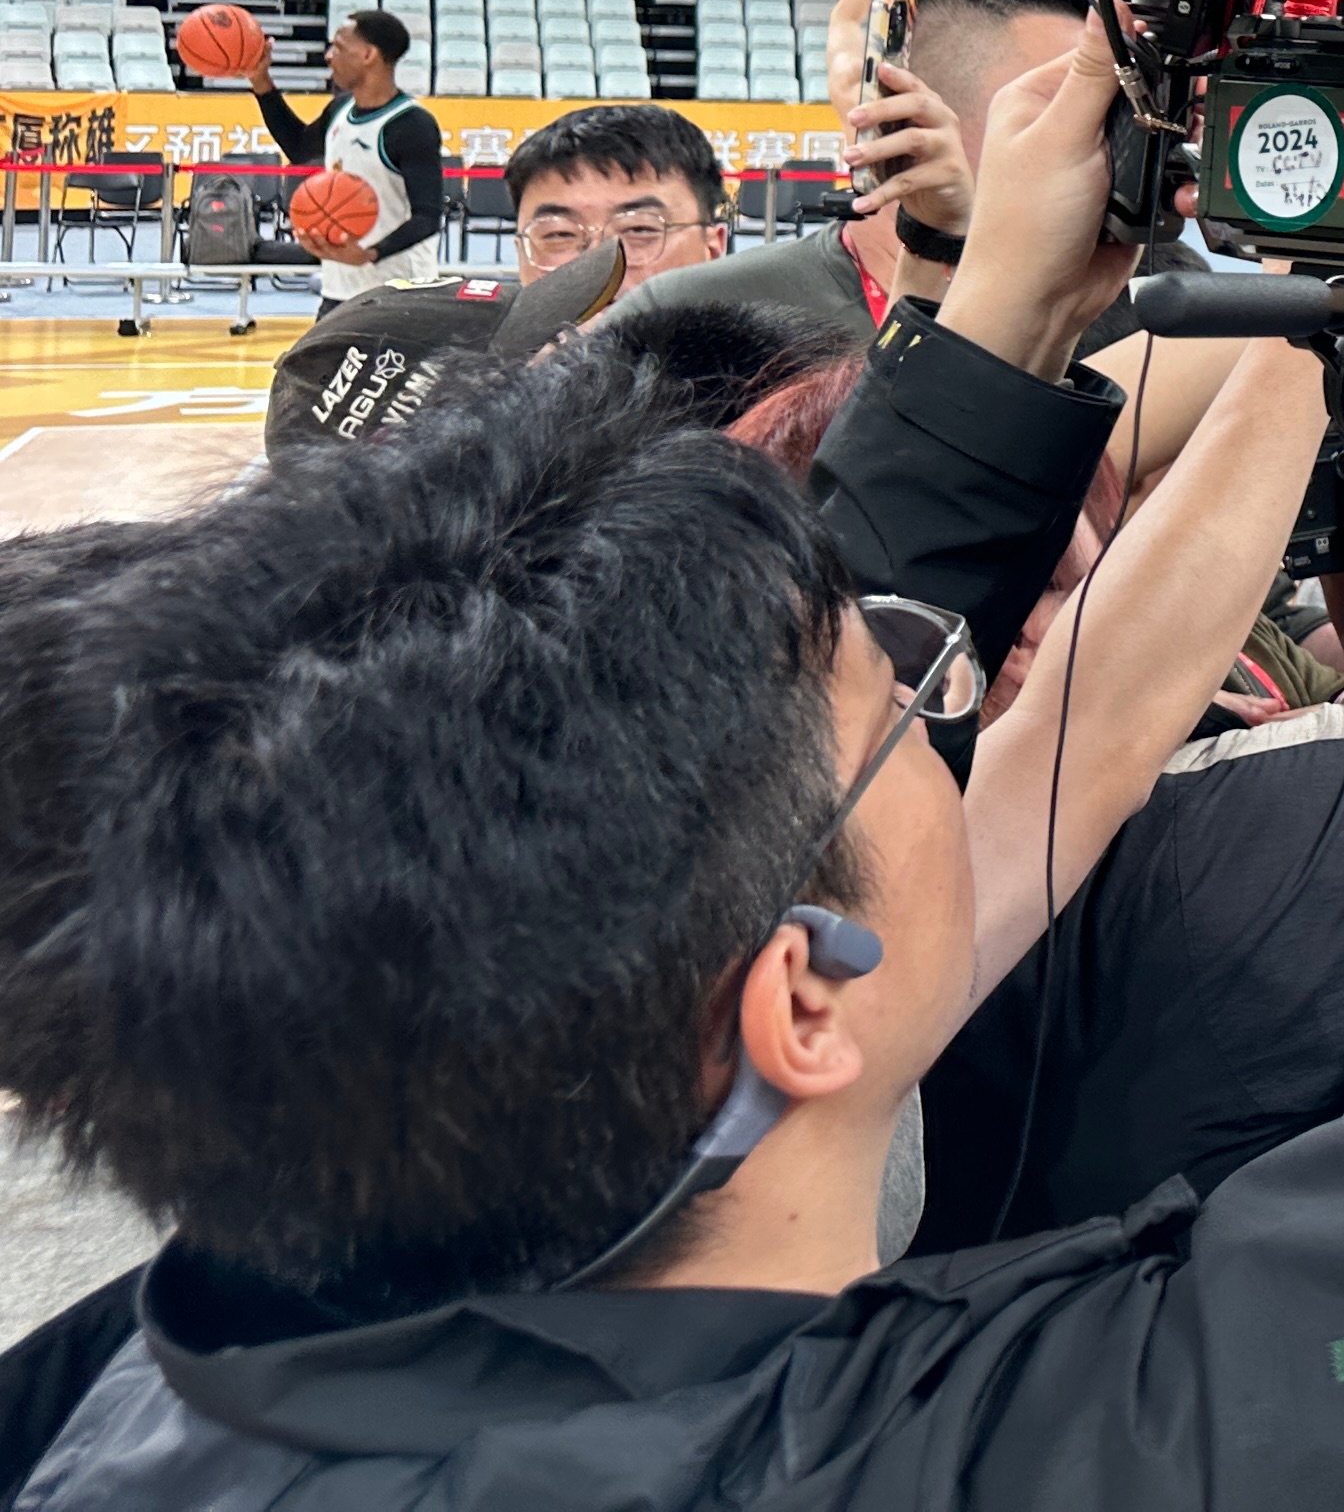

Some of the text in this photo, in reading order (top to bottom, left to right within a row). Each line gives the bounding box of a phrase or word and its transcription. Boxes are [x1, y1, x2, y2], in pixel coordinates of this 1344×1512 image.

[1257, 128, 1318, 154] 2024
[1258, 118, 1318, 130] ROLAND-GARROS
[311, 345, 369, 424] LAZER
[337, 374, 389, 440] AGU
[380, 360, 446, 426] VISMA
